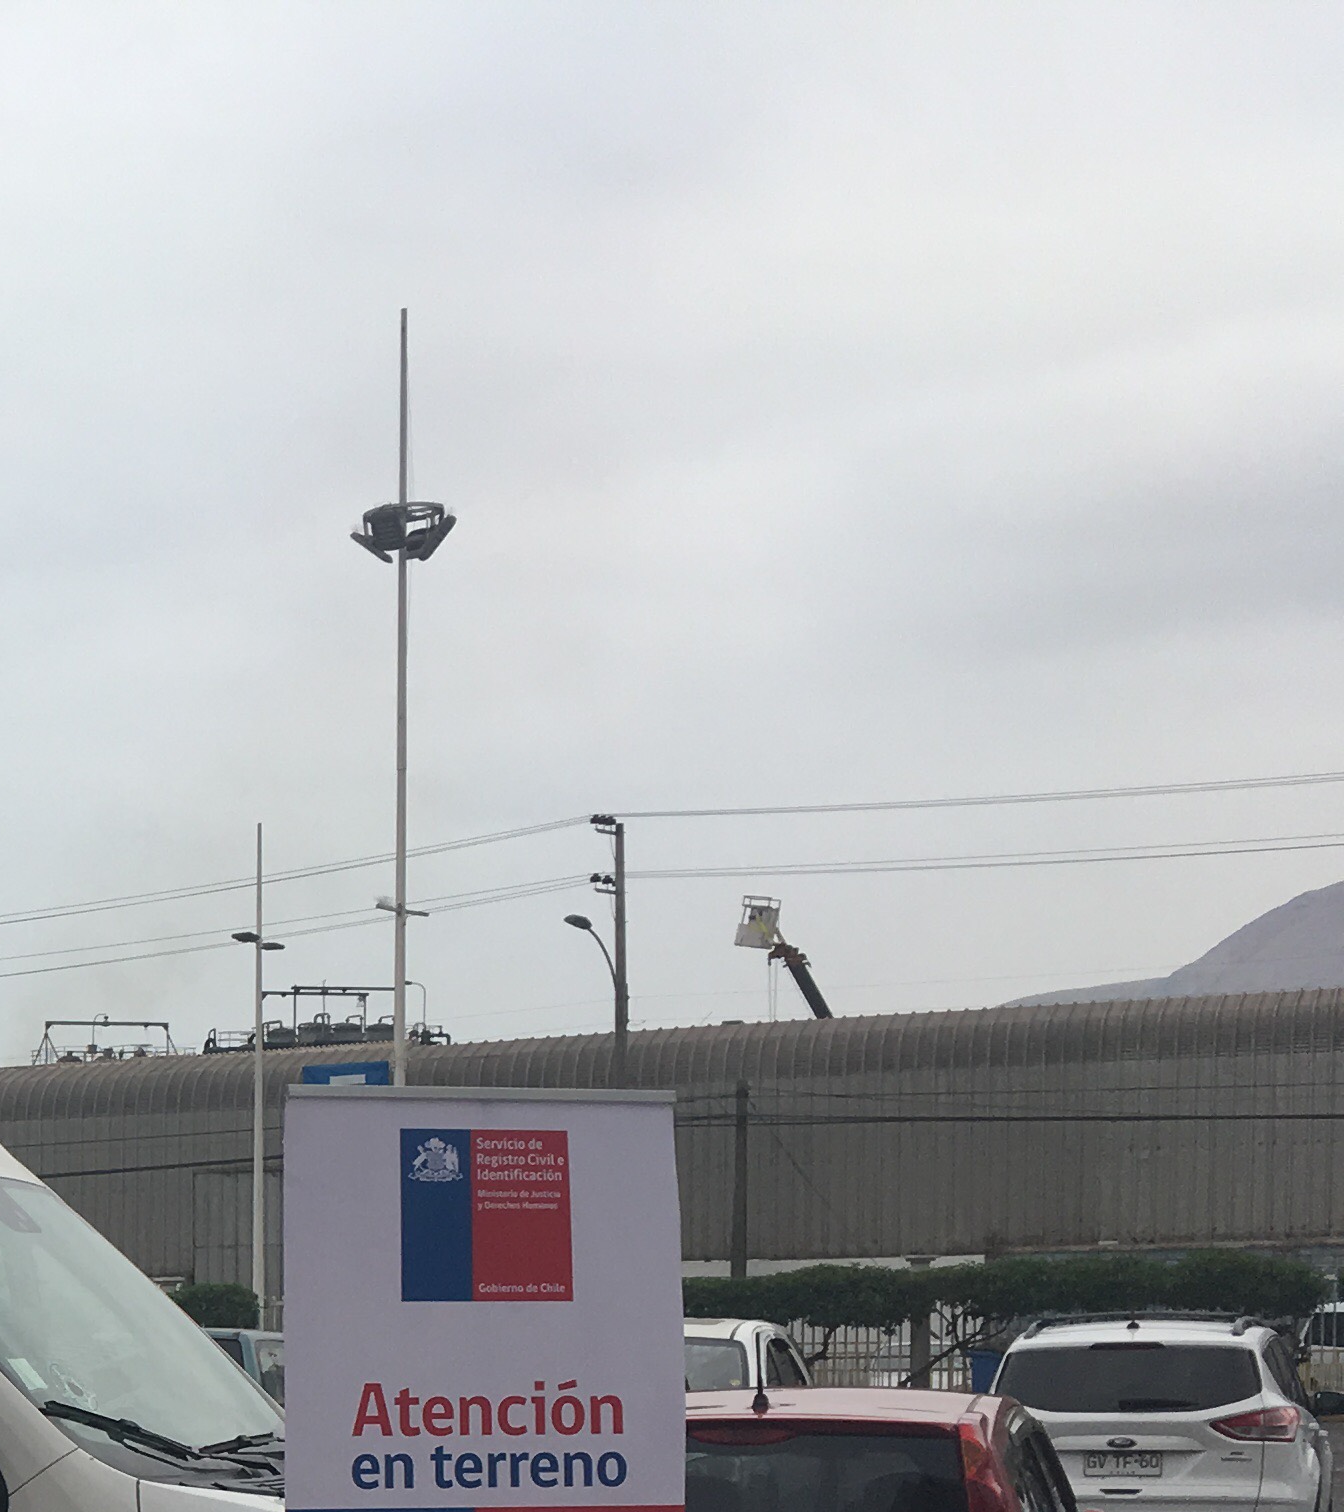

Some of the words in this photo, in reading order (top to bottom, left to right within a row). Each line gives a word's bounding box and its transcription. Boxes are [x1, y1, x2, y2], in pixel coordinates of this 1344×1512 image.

[476, 1137, 525, 1150] Servicio
[528, 1138, 543, 1150] de
[476, 1153, 525, 1167] Registro
[527, 1153, 555, 1165] Civil
[557, 1156, 565, 1165] e
[477, 1168, 563, 1181] Identificación
[478, 1283, 524, 1293] Gobierno
[526, 1283, 538, 1293] de
[540, 1282, 566, 1293] Chile
[351, 1379, 624, 1437] Atención
[351, 1453, 415, 1490] en
[429, 1445, 628, 1489] terreno
